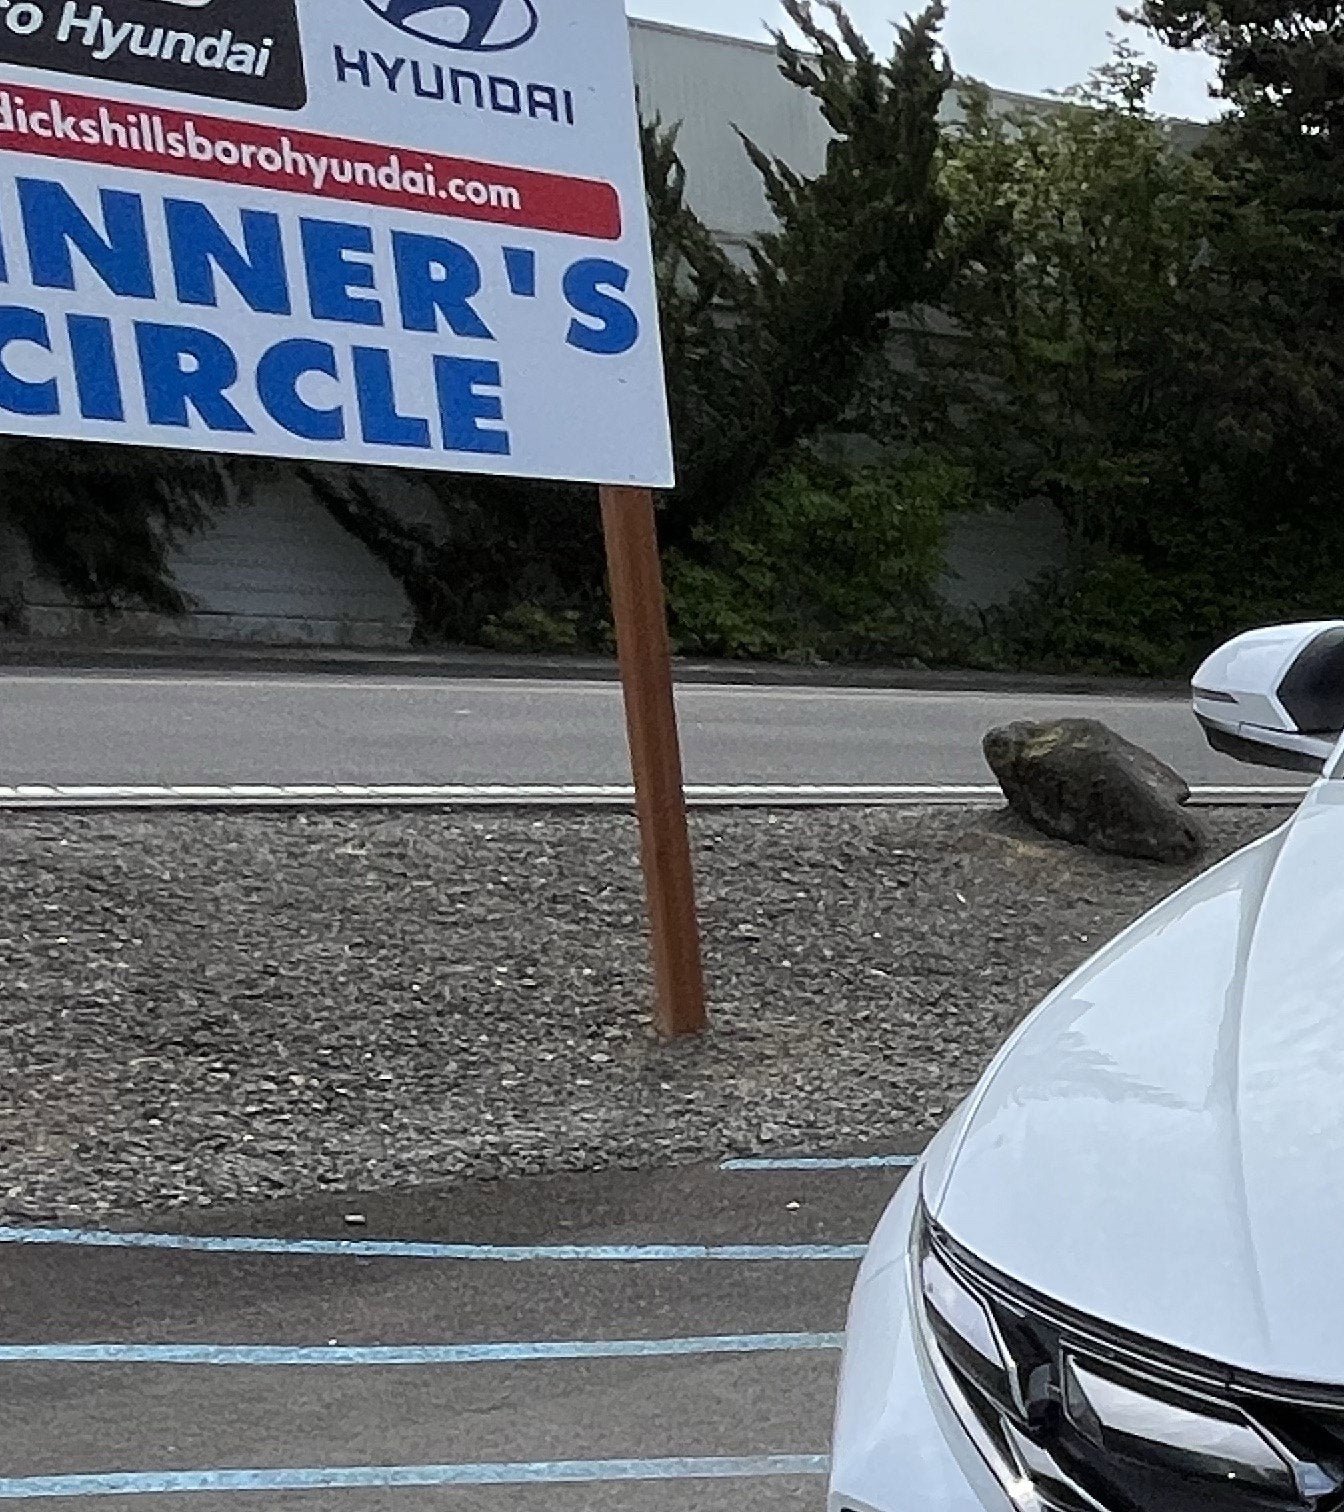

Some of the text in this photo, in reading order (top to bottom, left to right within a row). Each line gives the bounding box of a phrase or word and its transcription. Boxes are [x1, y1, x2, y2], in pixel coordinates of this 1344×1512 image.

[56, 0, 273, 77] Hyundai
[334, 45, 576, 125] HYUNDAI
[0, 176, 640, 356] NNER'S
[0, 306, 512, 456] CIRCLE
